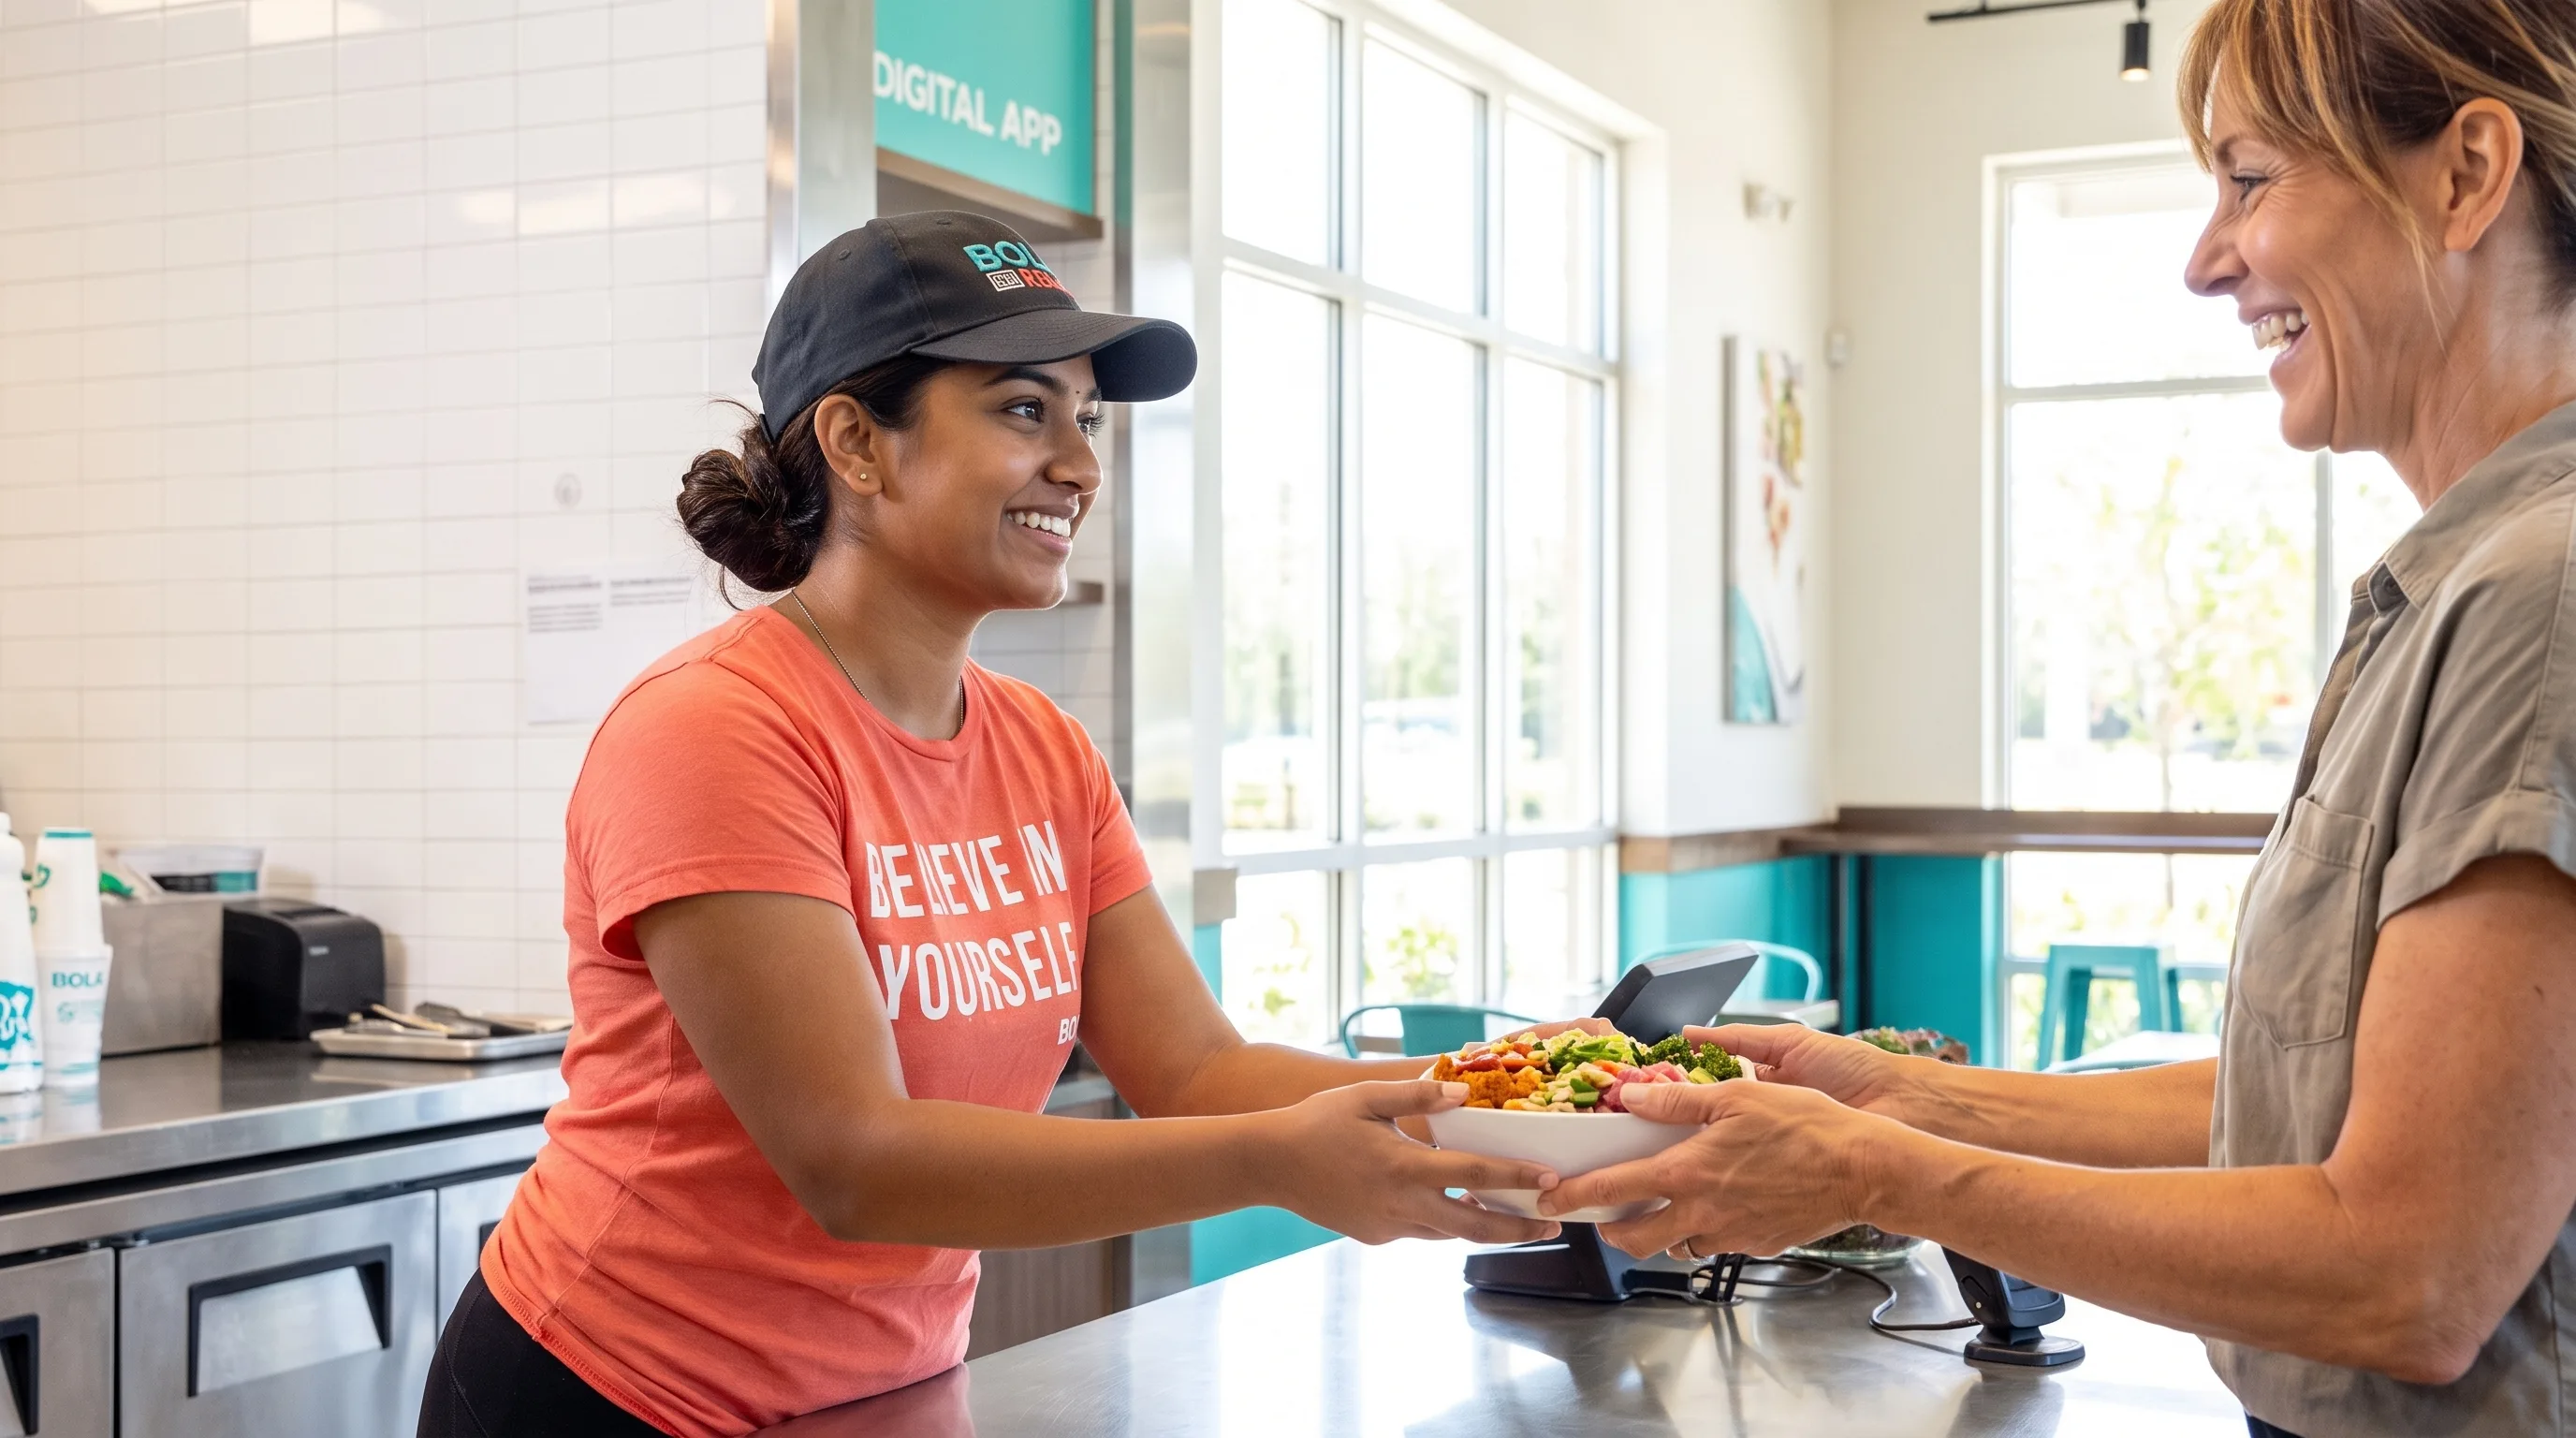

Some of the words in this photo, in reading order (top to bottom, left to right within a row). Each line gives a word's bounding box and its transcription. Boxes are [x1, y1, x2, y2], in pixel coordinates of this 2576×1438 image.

[873, 51, 994, 137] DIGITAL
[1001, 99, 1061, 156] APP
[866, 835, 1025, 918] BELIEVE
[1017, 820, 1067, 896] IN
[878, 922, 1077, 1020] YOURSELF
